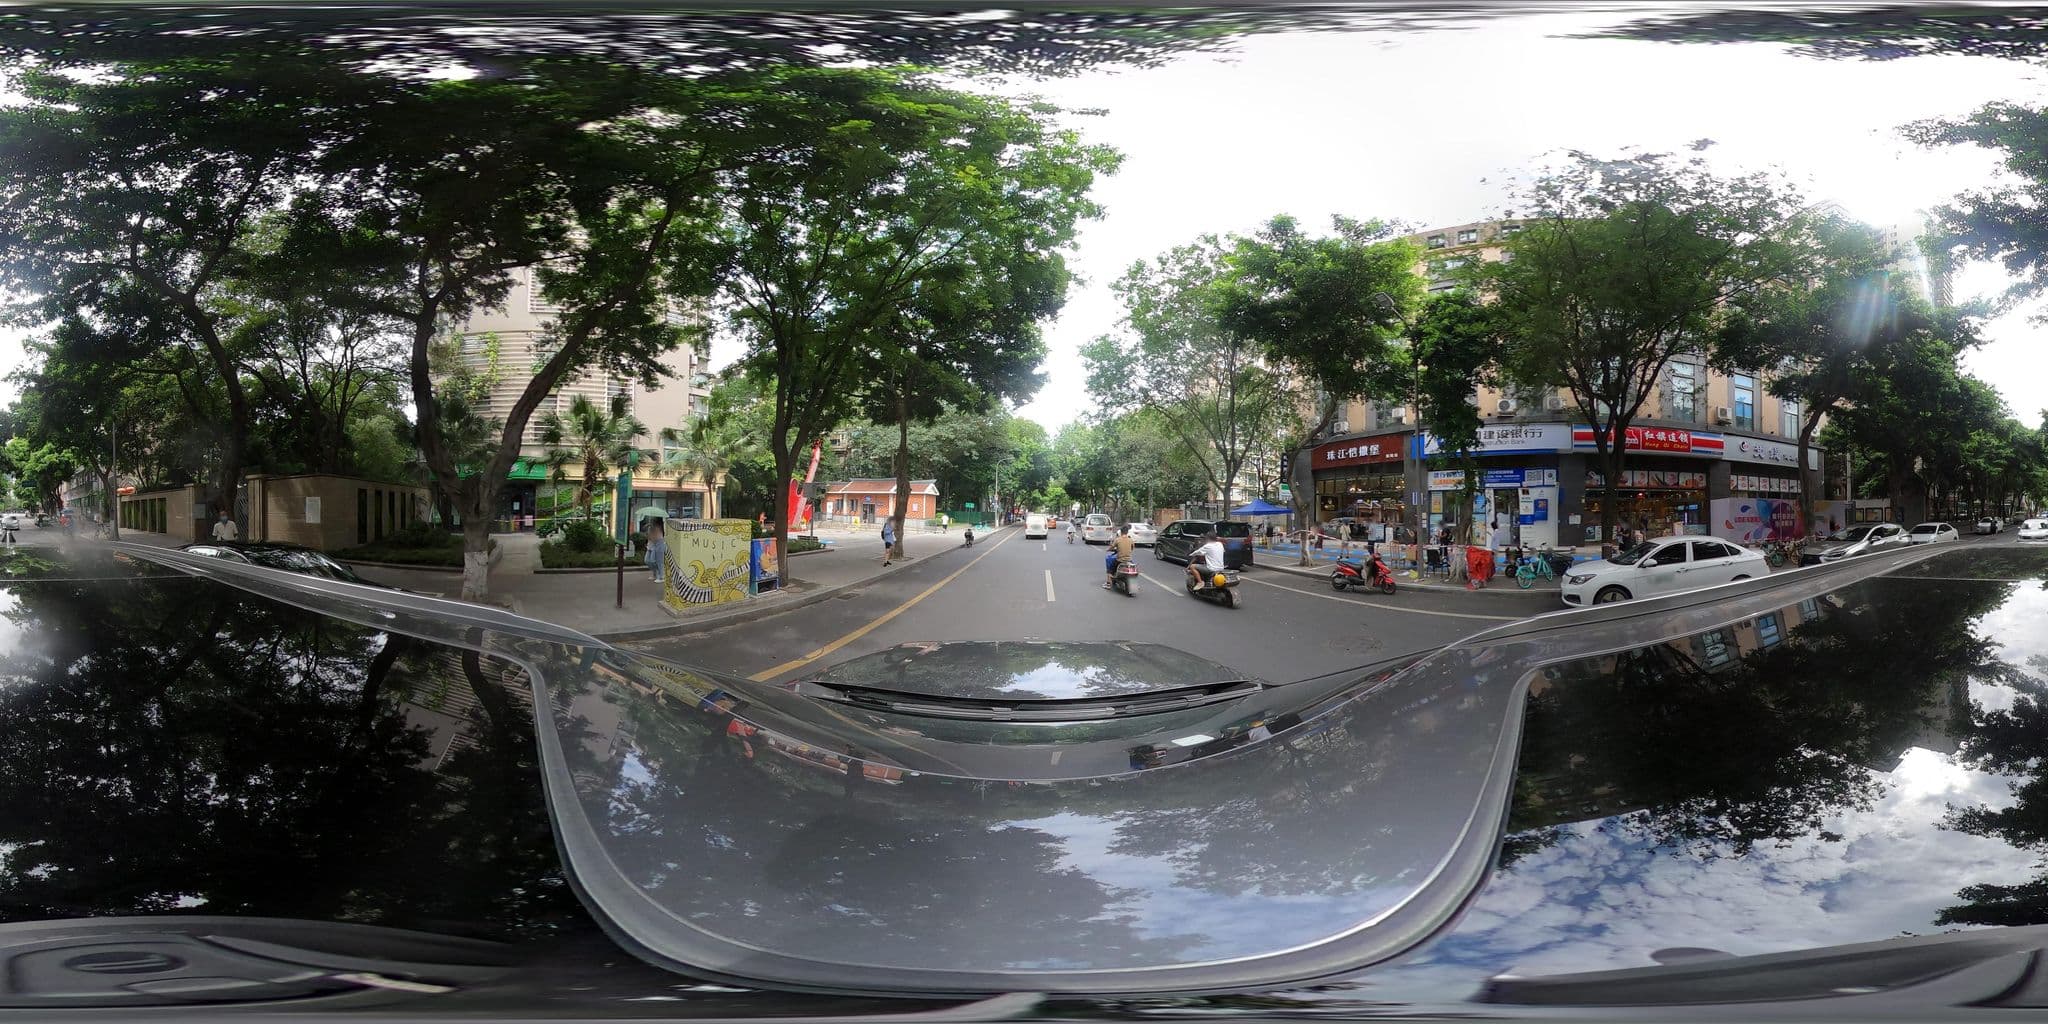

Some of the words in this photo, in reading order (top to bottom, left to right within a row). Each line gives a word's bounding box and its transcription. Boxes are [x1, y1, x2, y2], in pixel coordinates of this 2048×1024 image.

[1477, 428, 1543, 440] 建设银行
[1644, 430, 1689, 444] 红旗连锁
[692, 537, 737, 550] MUSIC
